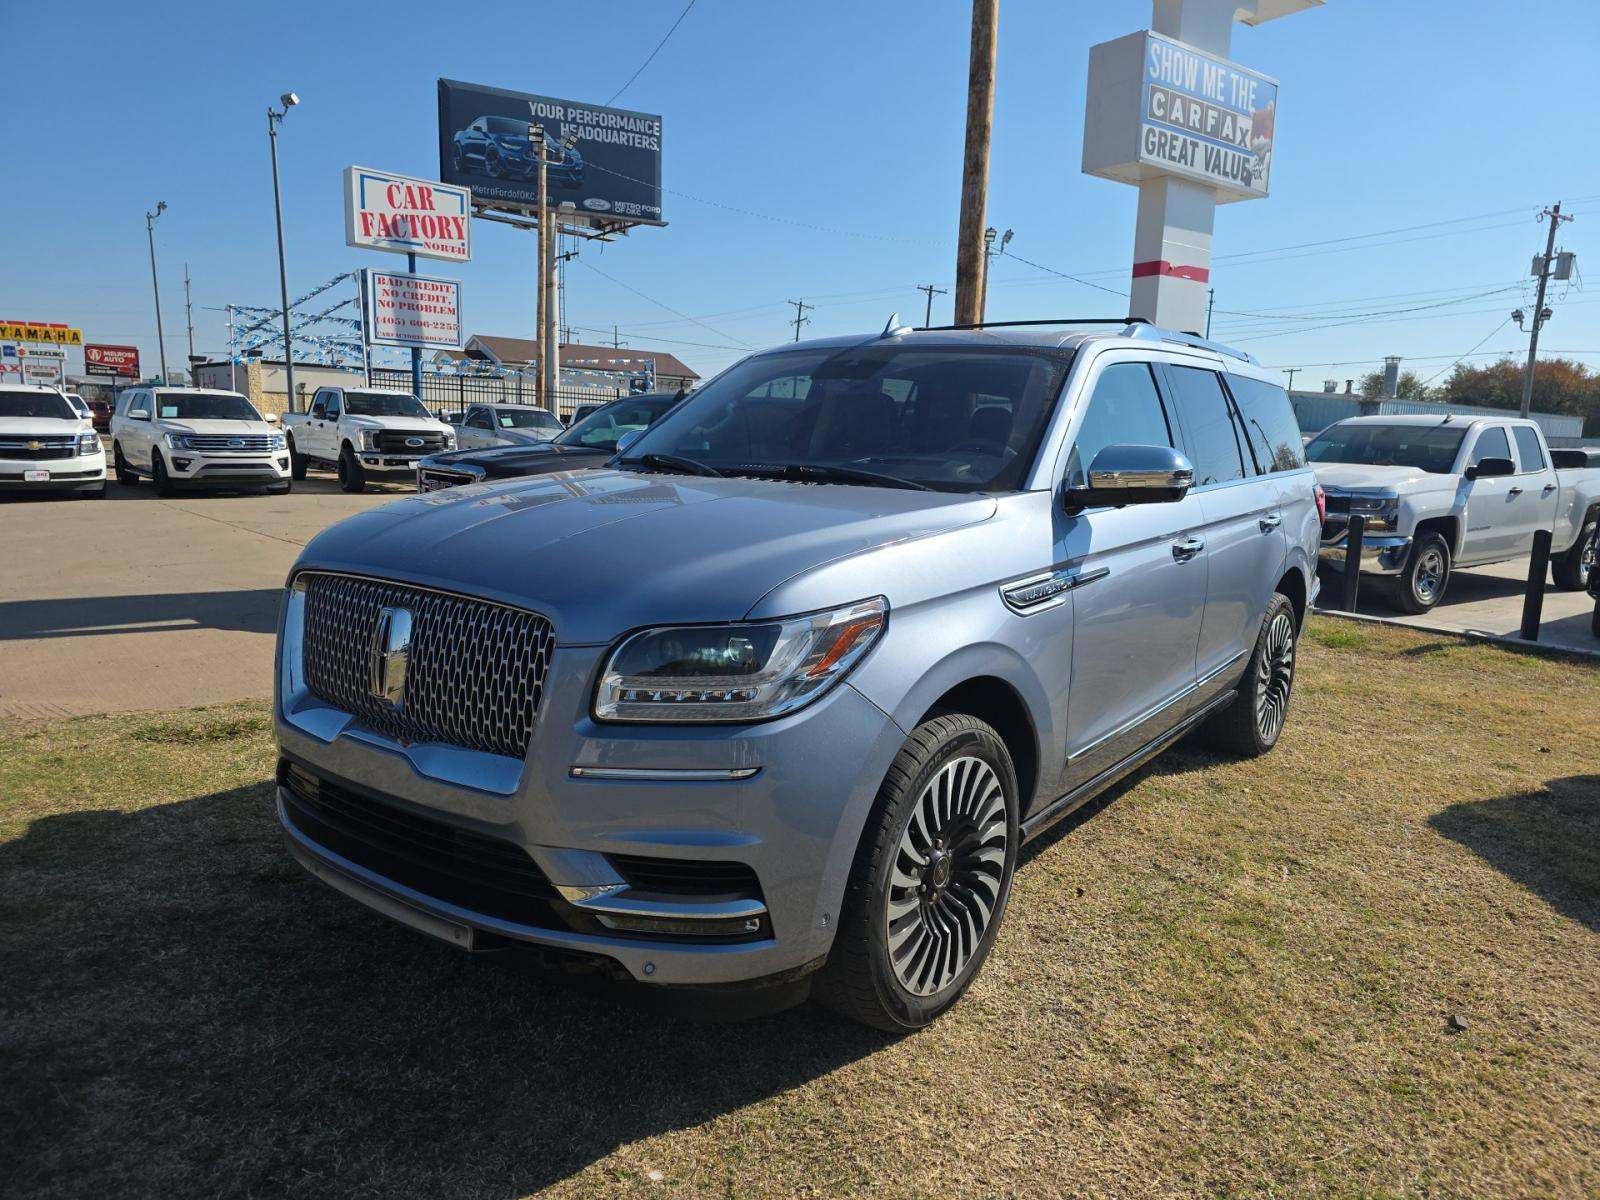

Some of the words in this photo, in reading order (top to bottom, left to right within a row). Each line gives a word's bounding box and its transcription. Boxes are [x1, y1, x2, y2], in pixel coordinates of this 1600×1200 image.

[1149, 43, 1199, 92] SHOW
[1203, 63, 1226, 102] ME
[1230, 73, 1258, 112] THE
[528, 101, 565, 121] YOUR
[567, 108, 660, 136] PERFORMANCE
[1152, 91, 1250, 148] CARFAX
[560, 122, 660, 152] HEADQUARTERS.
[1144, 127, 1199, 167] GREAT
[386, 182, 435, 211] CAR
[614, 201, 641, 210] METRO
[641, 204, 661, 214] FORD
[625, 208, 642, 216] OKC
[360, 211, 466, 241] FACTORY
[423, 241, 466, 255] NORTH
[377, 276, 403, 287] BAD
[382, 288, 401, 299] NO
[377, 300, 395, 309] NO
[398, 302, 456, 315] PROBLEM
[375, 316, 406, 326] (405)
[0, 327, 80, 342] YAMAHA
